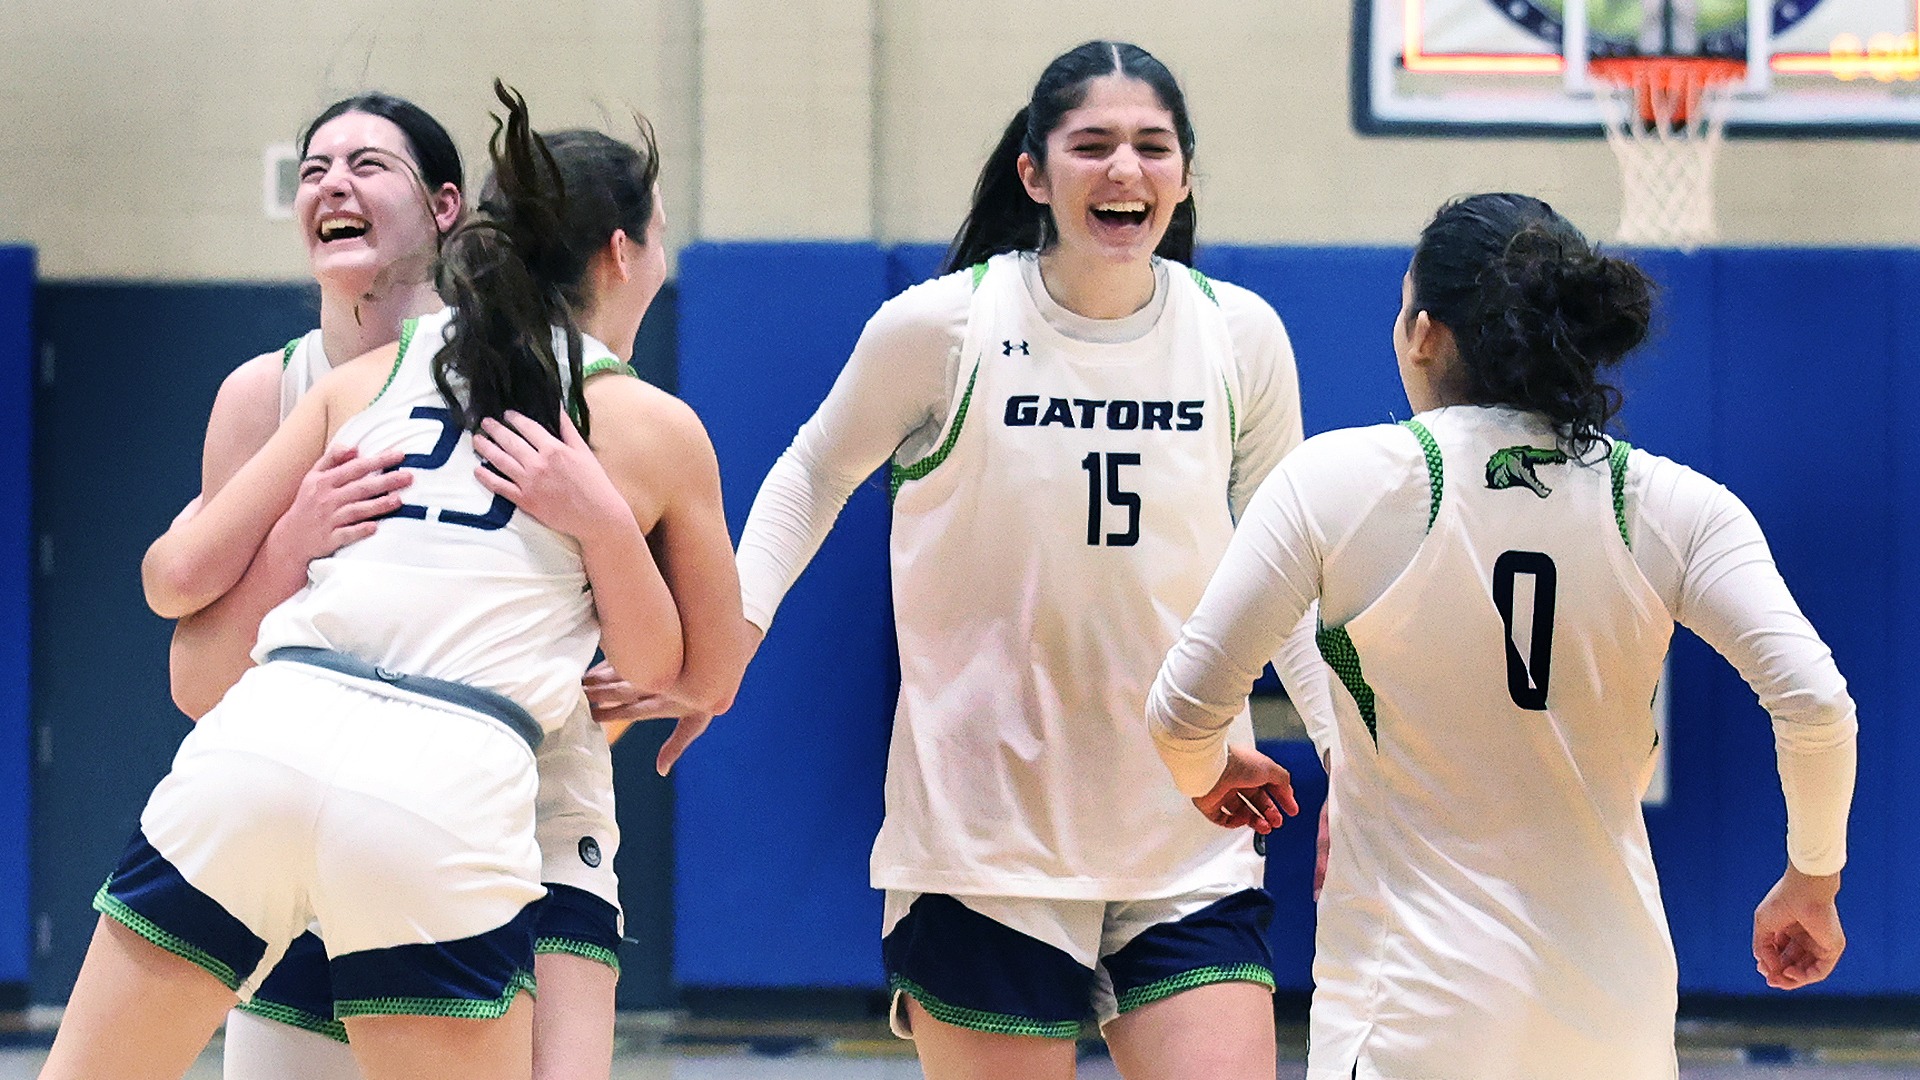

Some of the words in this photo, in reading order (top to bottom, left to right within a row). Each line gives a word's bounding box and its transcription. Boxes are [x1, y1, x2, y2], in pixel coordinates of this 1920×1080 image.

[1004, 396, 1205, 431] GATORS
[1082, 452, 1141, 546] 15
[1493, 550, 1556, 710] 0
